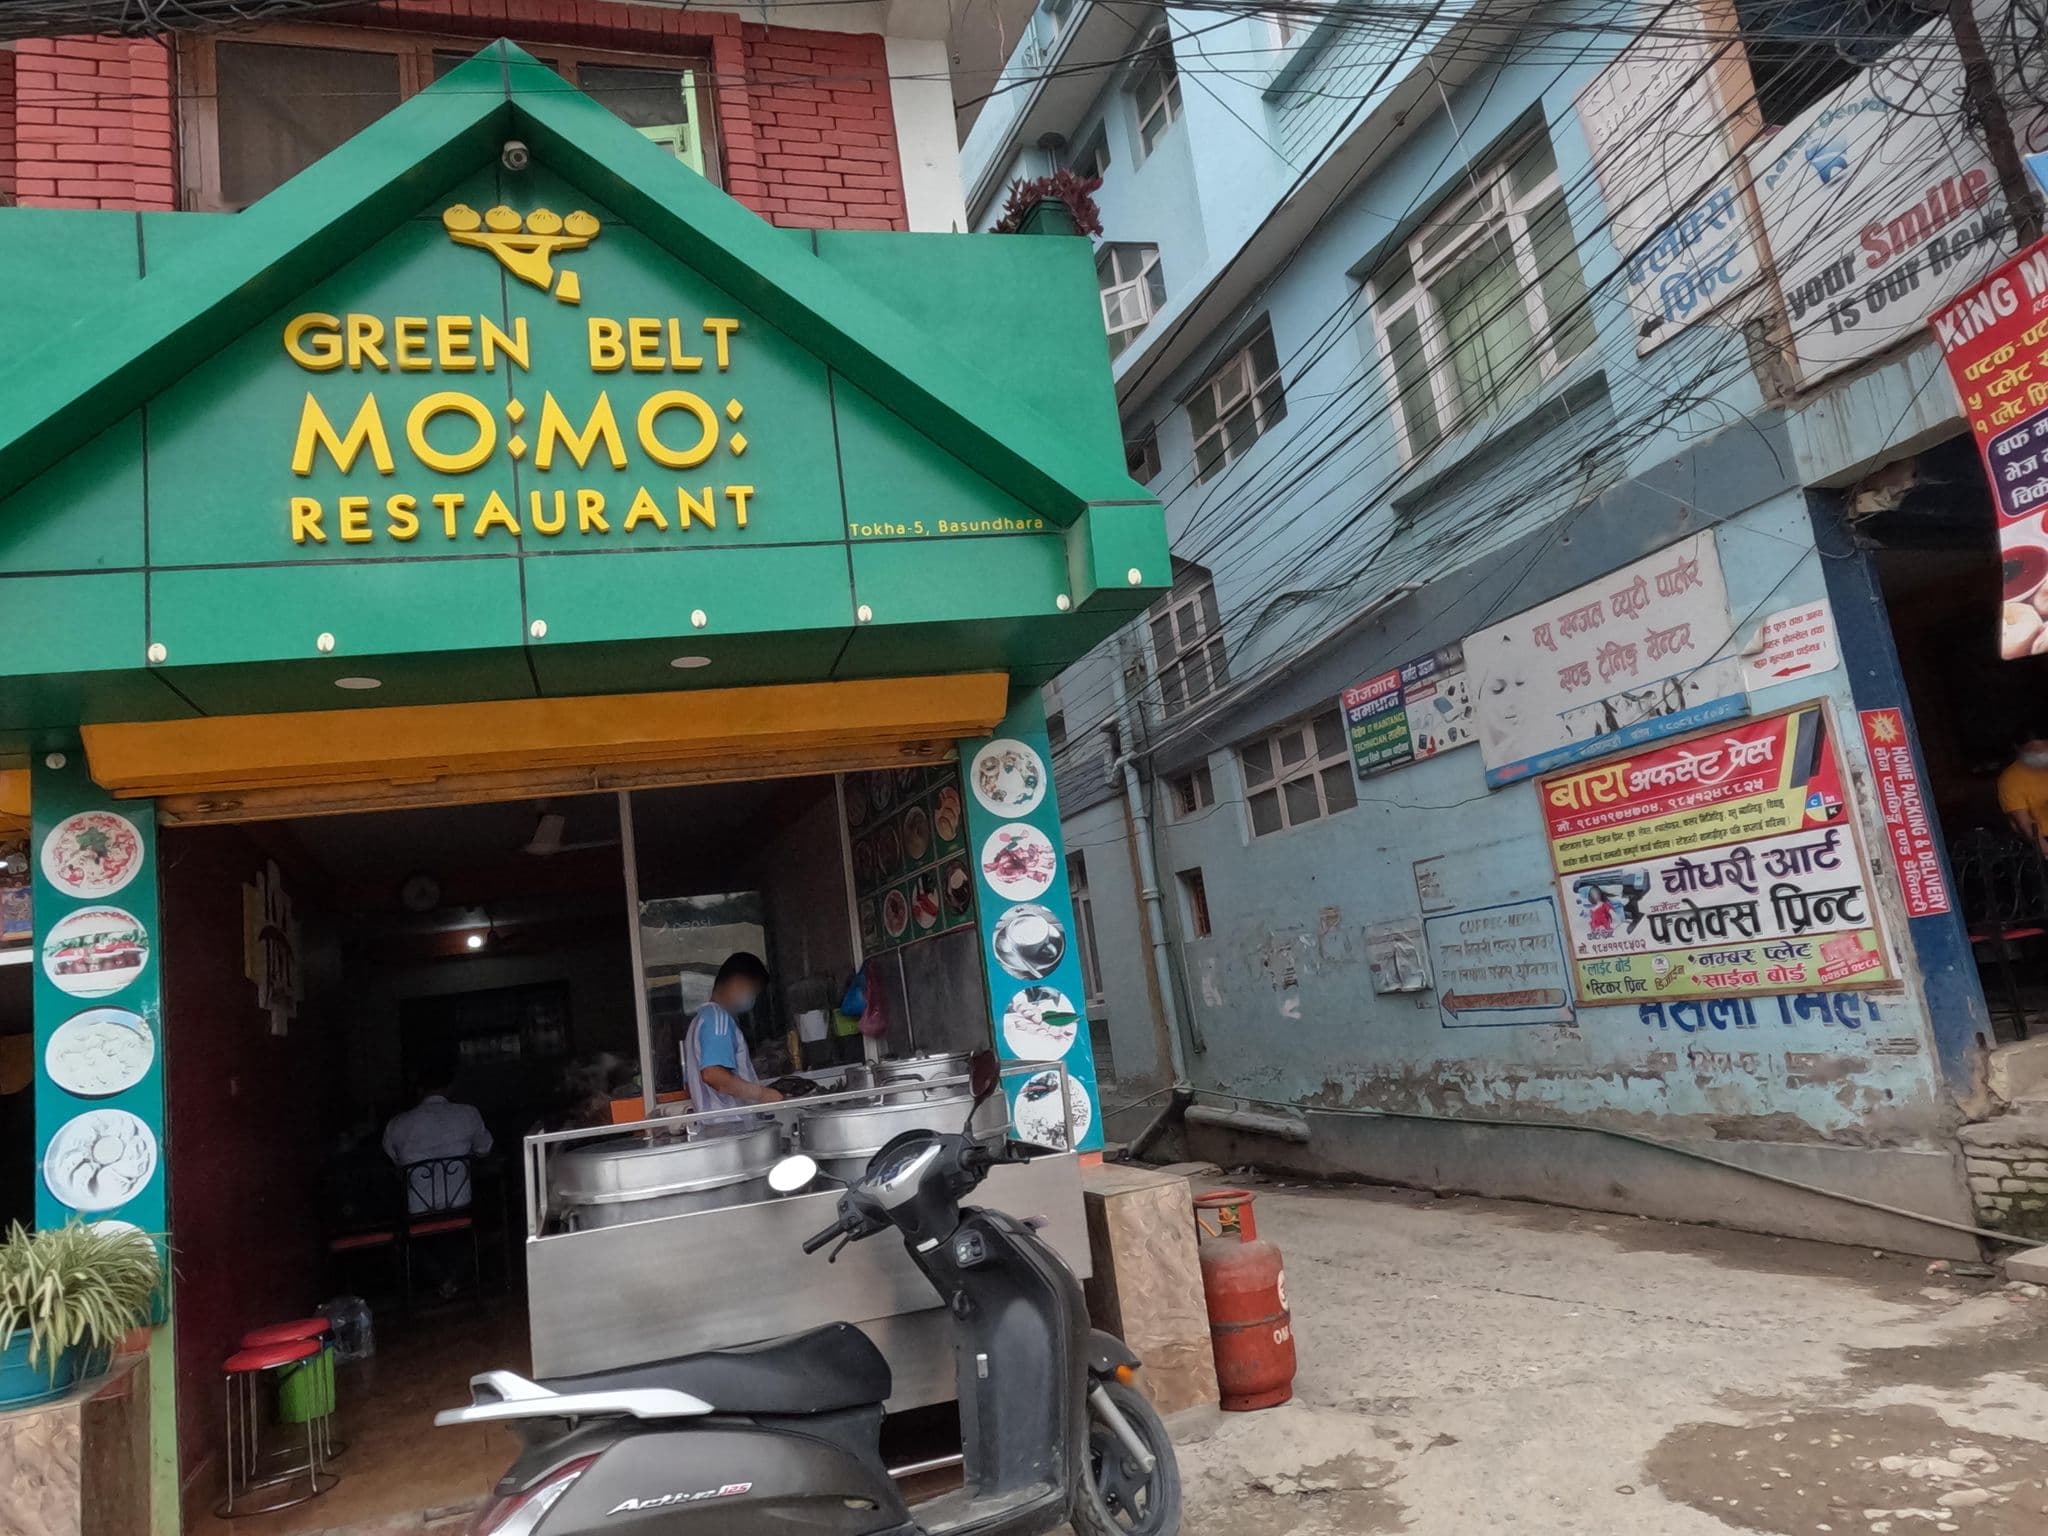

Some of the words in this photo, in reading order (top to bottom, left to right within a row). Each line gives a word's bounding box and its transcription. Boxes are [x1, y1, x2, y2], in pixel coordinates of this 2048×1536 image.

[1787, 251, 1857, 321] your
[1860, 168, 1990, 269] Smile
[1829, 301, 1861, 336] is
[1864, 256, 1920, 313] our
[1935, 277, 2019, 354] KING
[283, 312, 530, 373] GREEN
[587, 317, 740, 372] BELT
[290, 485, 755, 545] RESTAURANT
[850, 521, 930, 538] Tokha-5,
[938, 517, 1044, 535] Basundhara
[1546, 761, 1633, 810] बारा
[1629, 750, 1723, 793] अफसेट
[1706, 735, 1776, 777] प्रेस
[1891, 746, 1914, 781] HOME
[1901, 783, 1928, 837] PACKING
[1661, 845, 1762, 895] चौधरी
[1765, 828, 1841, 878] आर्ट
[1914, 839, 1931, 849] &
[1918, 852, 1949, 912] DELIVERY
[1647, 898, 1762, 945] फ्लेक्स
[1771, 882, 1867, 935] प्रिन्ट
[1698, 945, 1757, 967] नम्बर
[1764, 940, 1812, 961] प्लेट
[1767, 962, 1809, 985] बोर्ड
